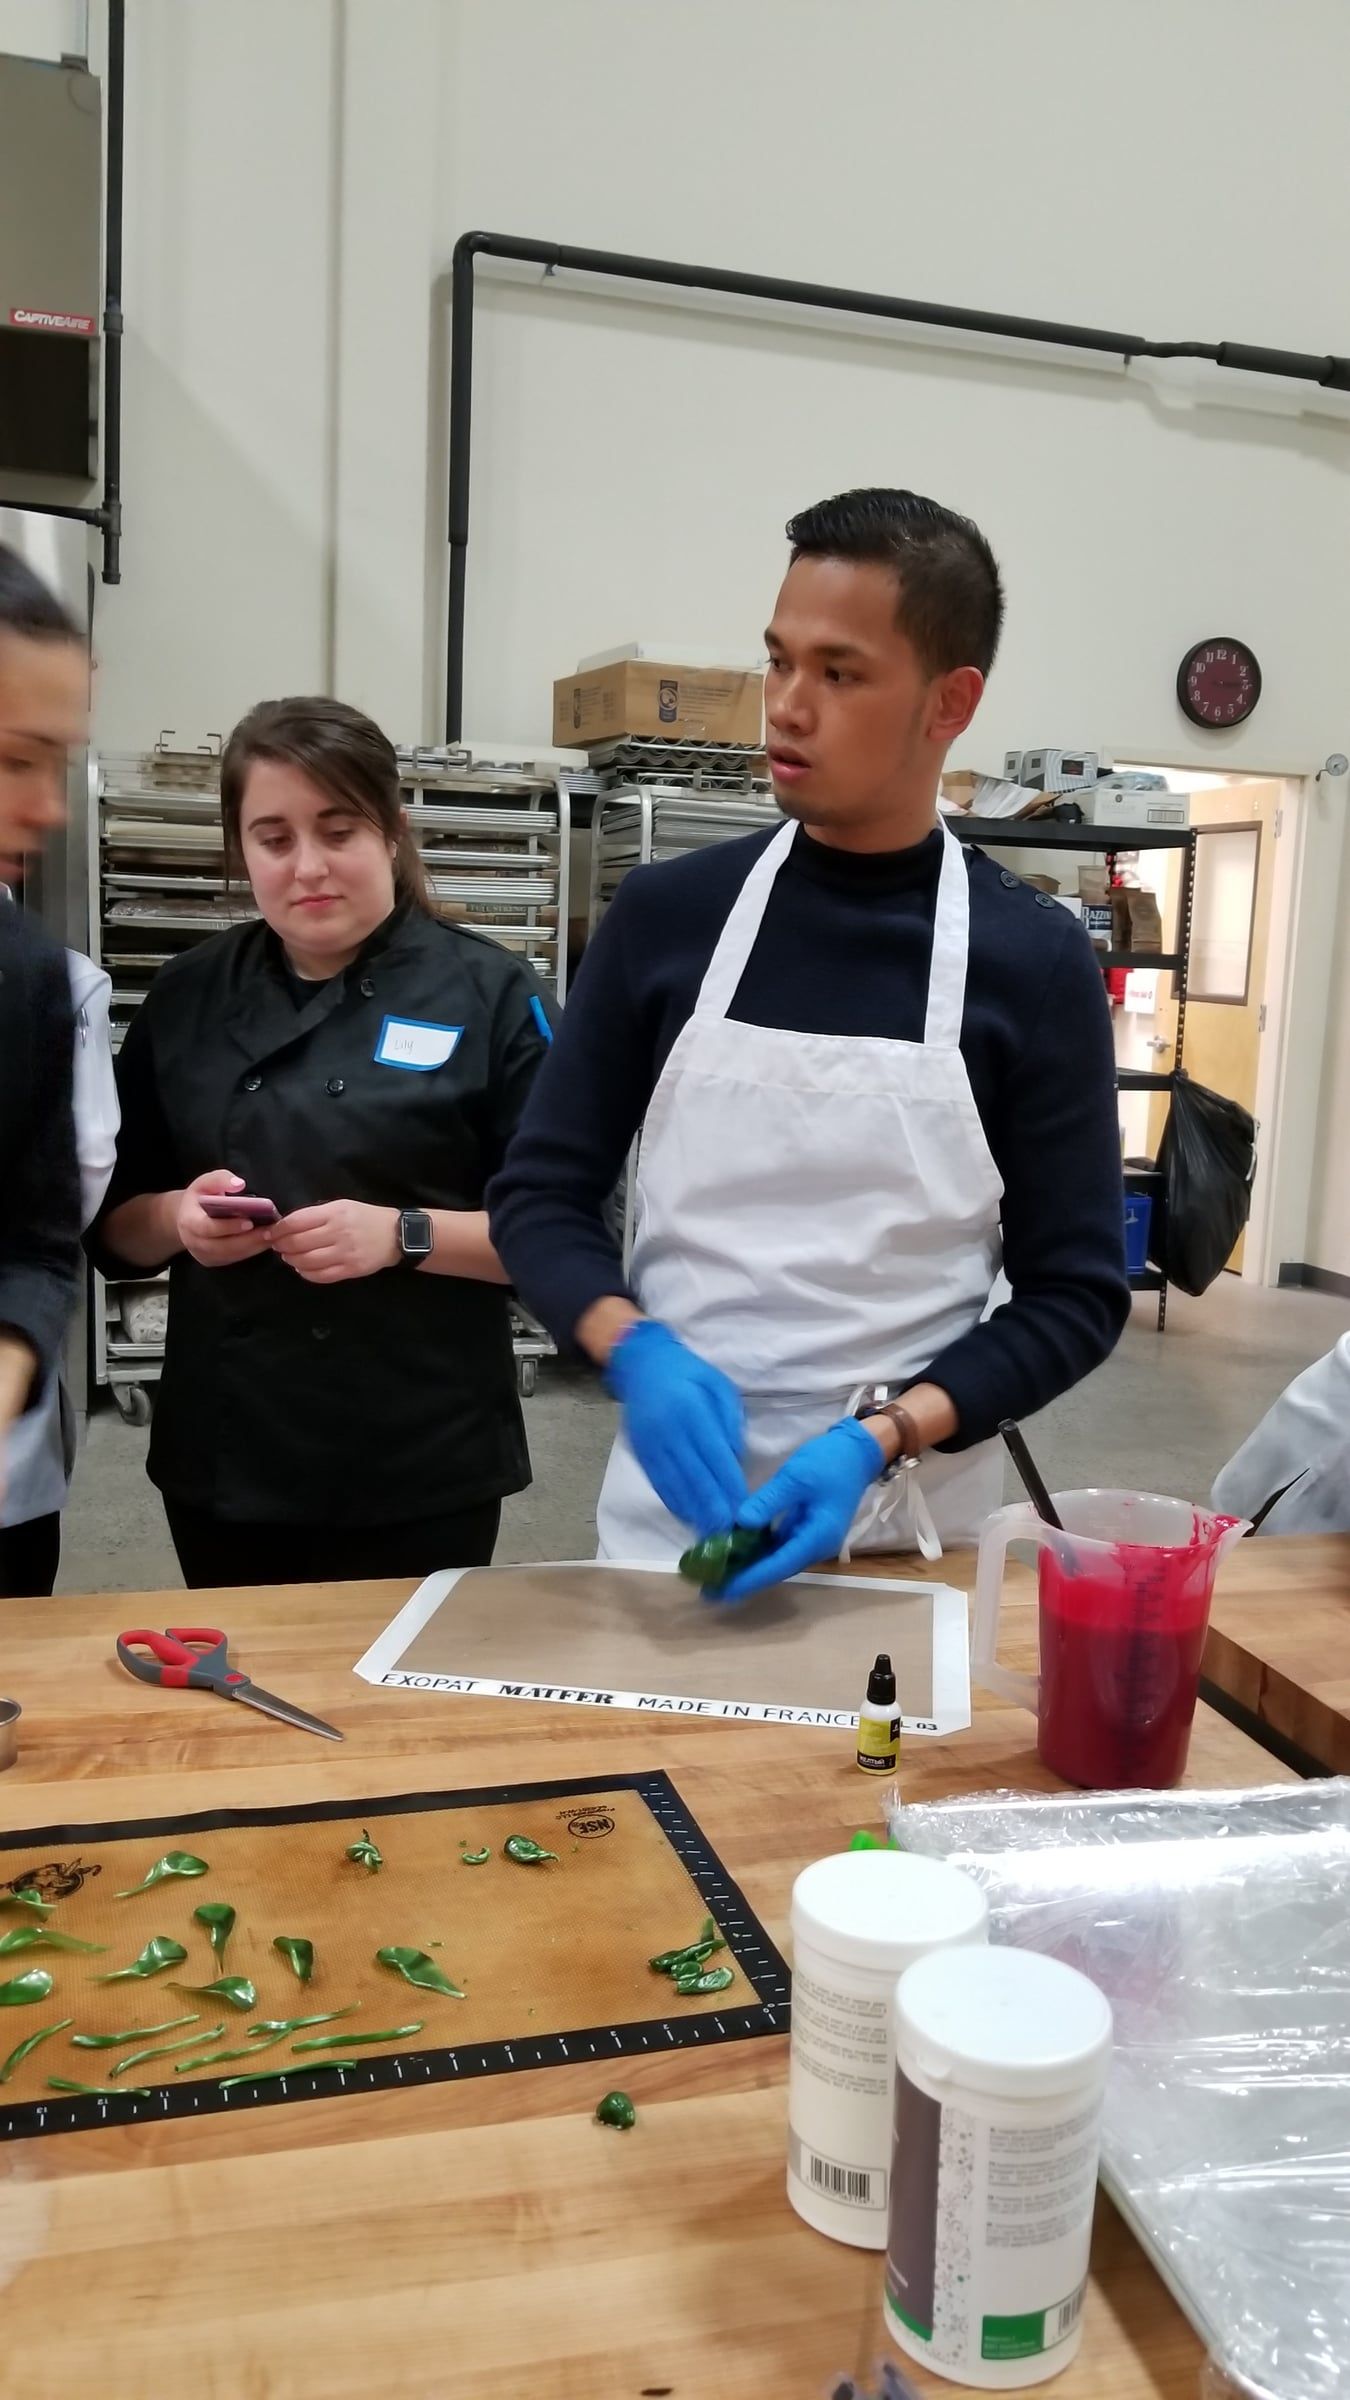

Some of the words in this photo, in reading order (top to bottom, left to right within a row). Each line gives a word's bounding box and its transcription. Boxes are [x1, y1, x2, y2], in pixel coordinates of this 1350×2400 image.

[1206, 651, 1214, 662] 11
[1216, 649, 1227, 660] 12
[1232, 654, 1236, 664] 1
[1195, 662, 1206, 673] 10
[1240, 666, 1247, 677] 2
[1190, 676, 1197, 687] 9
[1194, 690, 1201, 701] 8
[1236, 693, 1243, 704] 4
[1203, 701, 1209, 712] 7
[1214, 706, 1221, 717] 6
[1227, 703, 1234, 714] 5
[394, 1039, 415, 1055] Lily
[380, 1673, 480, 1692] EXOPAT
[499, 1684, 615, 1704] MATFER
[637, 1697, 712, 1714] MADE
[722, 1704, 751, 1717] IN
[763, 1708, 860, 1727] FRANCE
[916, 1722, 938, 1731] 03
